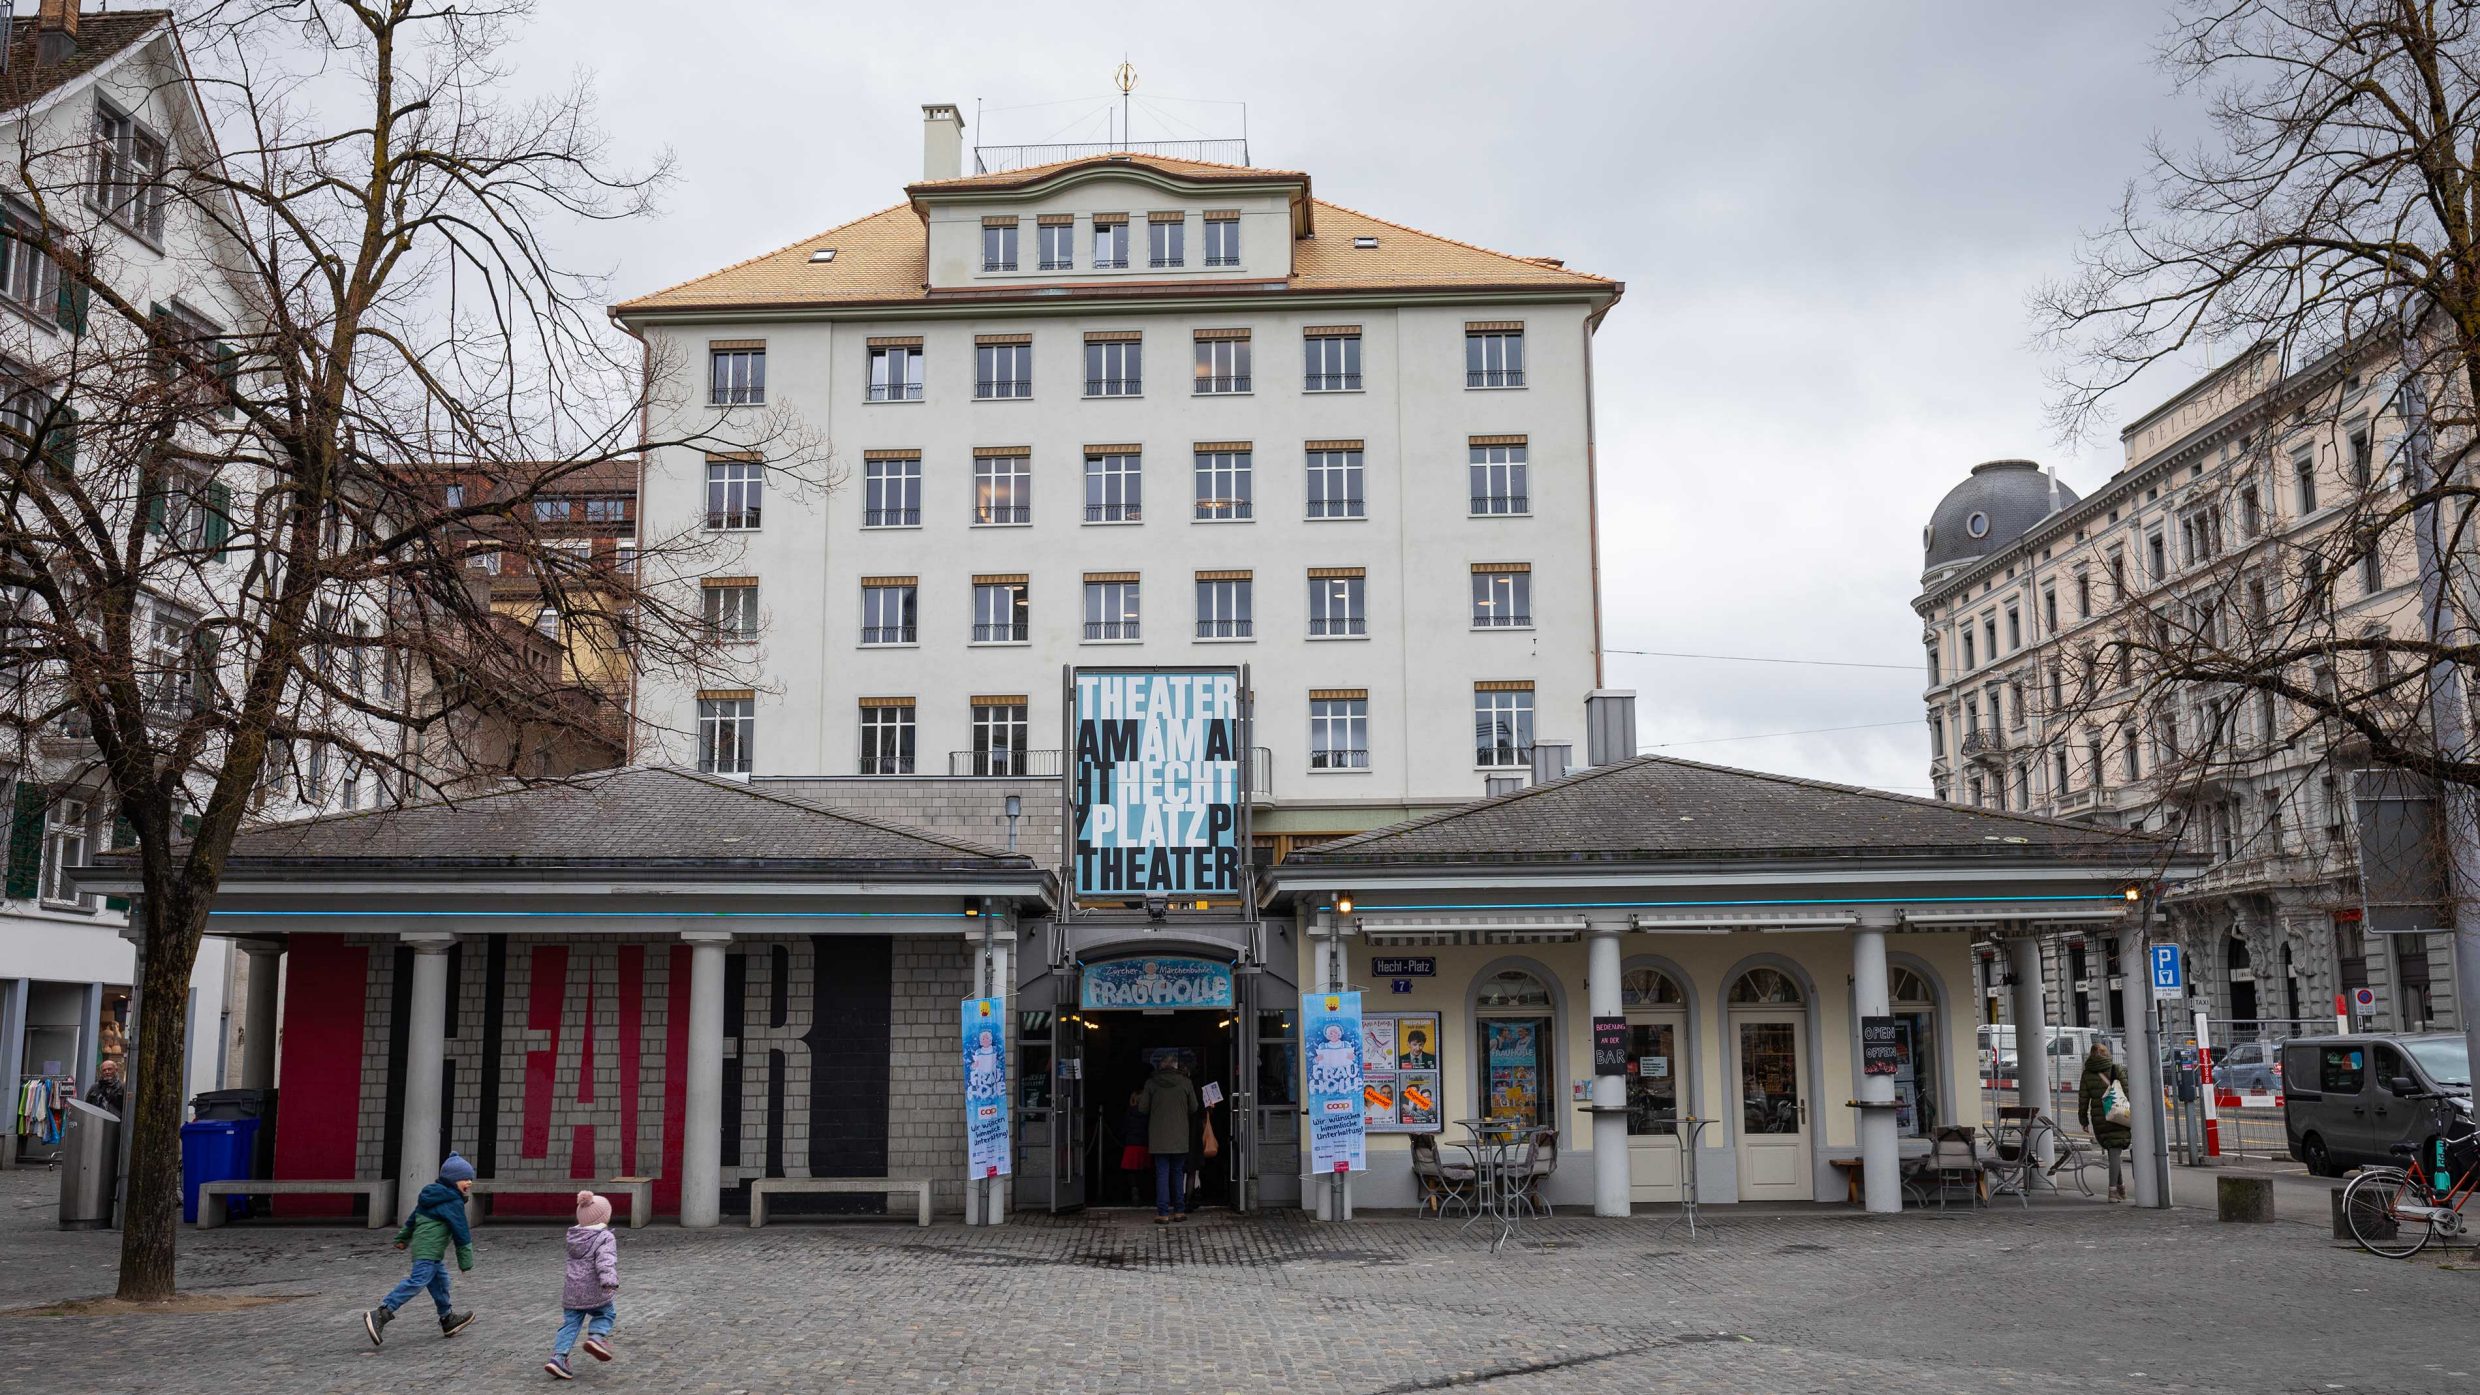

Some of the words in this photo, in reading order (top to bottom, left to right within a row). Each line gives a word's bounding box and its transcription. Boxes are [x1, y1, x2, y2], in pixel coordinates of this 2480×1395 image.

[1077, 676, 1237, 720] THEATER
[1117, 761, 1238, 804] HECHT
[1092, 803, 1208, 847] PLATZ
[1077, 847, 1238, 890] THEATER
[2158, 949, 2171, 969] P
[1088, 975, 1148, 1004] FRAU
[1151, 975, 1228, 1004] HOLLE
[1398, 981, 1405, 991] 7
[1864, 1026, 1896, 1040] OPEN
[1596, 1049, 1626, 1065] BAR
[1865, 1046, 1897, 1058] OFFEN
[1312, 1064, 1360, 1083] FRAU
[1308, 1078, 1364, 1095] HOLLE
[1326, 1102, 1350, 1110] coop
[1320, 1120, 1358, 1132] himmlische
[1328, 1113, 1361, 1123] wünschen
